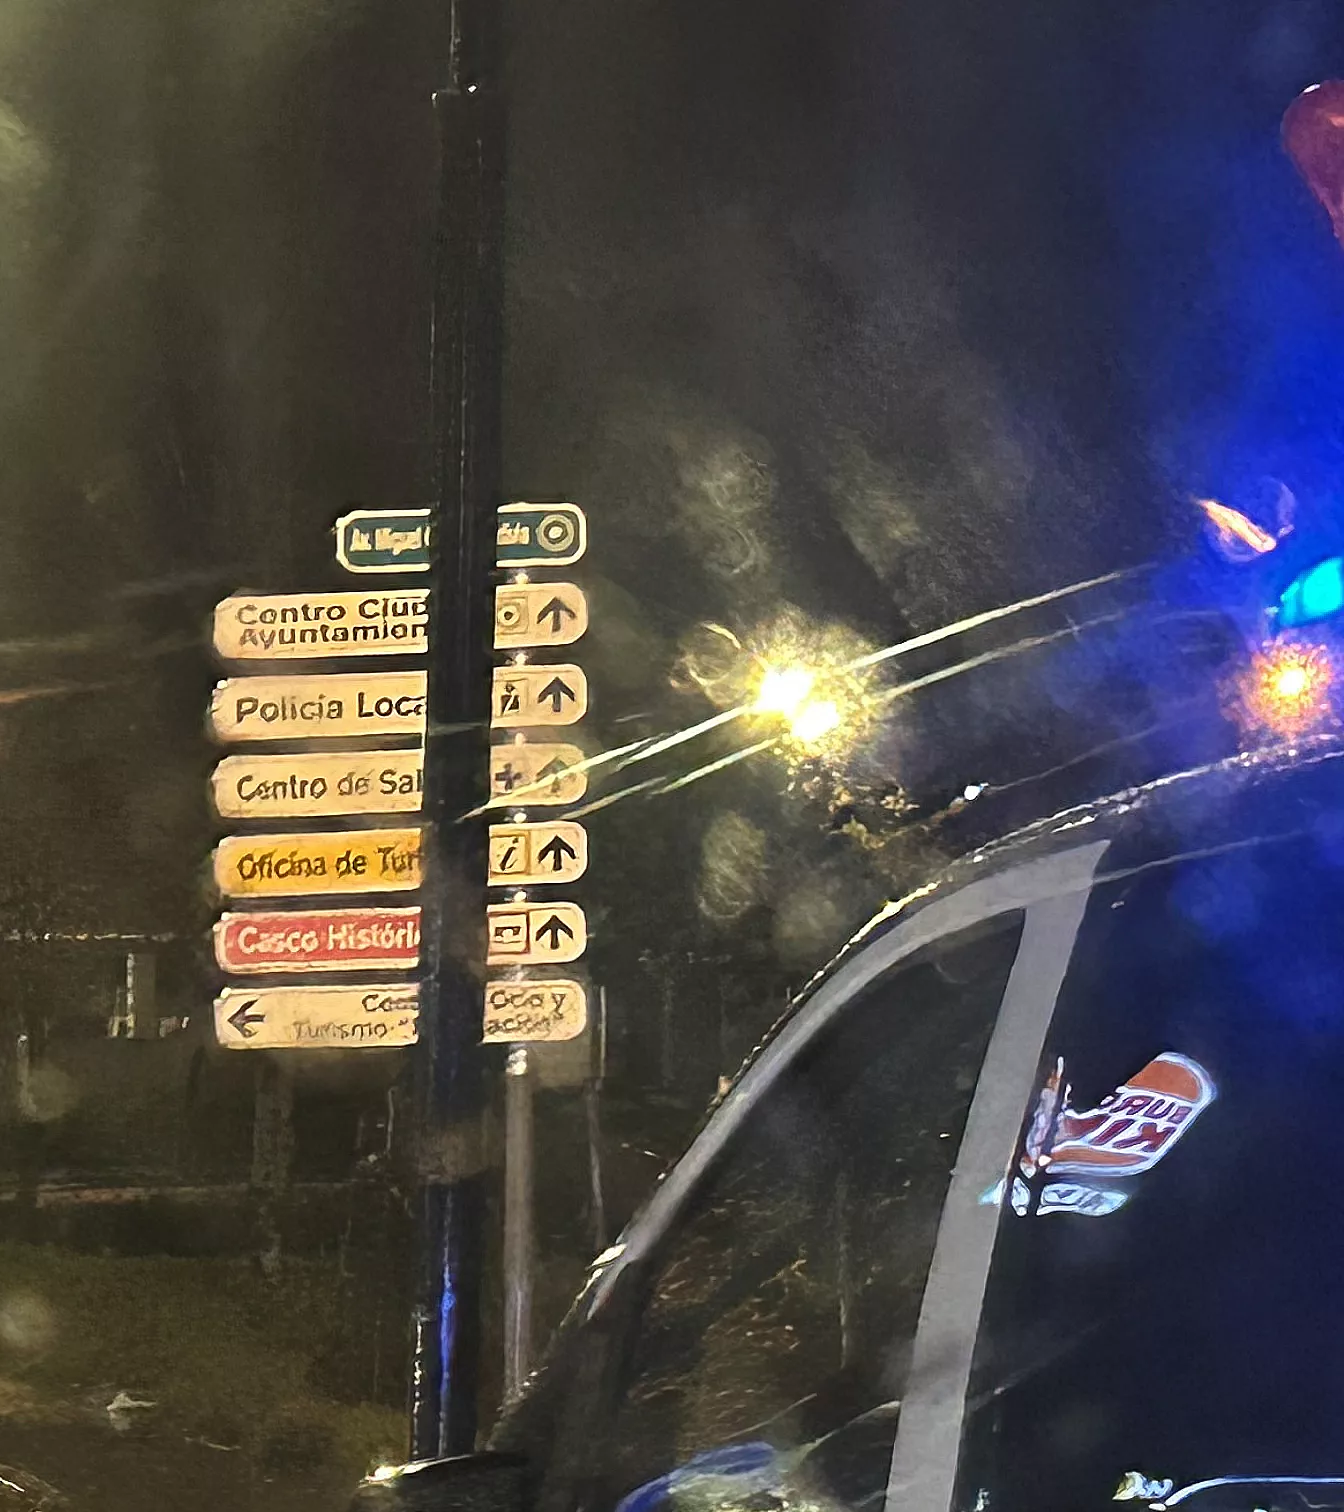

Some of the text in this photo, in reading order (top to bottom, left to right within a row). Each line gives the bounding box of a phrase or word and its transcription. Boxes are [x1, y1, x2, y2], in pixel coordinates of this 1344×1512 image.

[237, 773, 327, 801] Centro
[337, 769, 371, 796] de
[237, 848, 326, 880] Oficina
[335, 849, 368, 878] de
[238, 926, 318, 954] Casco
